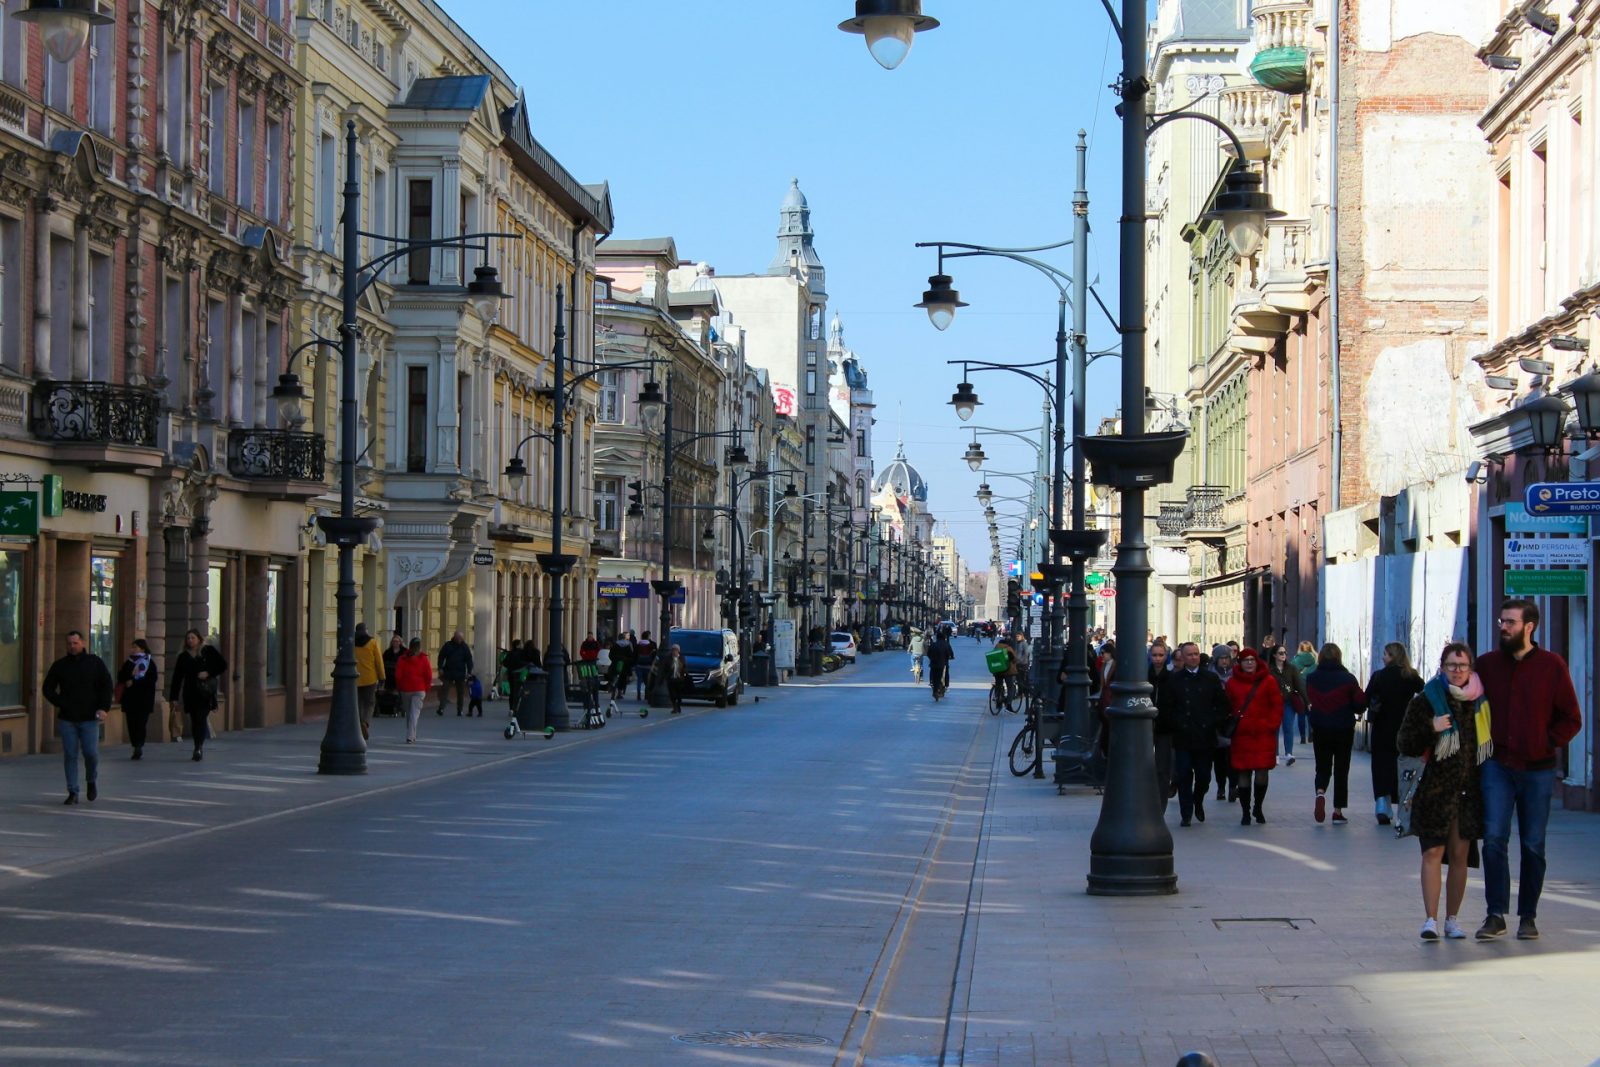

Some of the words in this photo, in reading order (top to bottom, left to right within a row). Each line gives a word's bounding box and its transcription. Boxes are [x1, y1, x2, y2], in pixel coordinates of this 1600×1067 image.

[1555, 488, 1599, 500] Preto
[1522, 543, 1540, 551] HMD
[1541, 543, 1579, 551] PERSONAL
